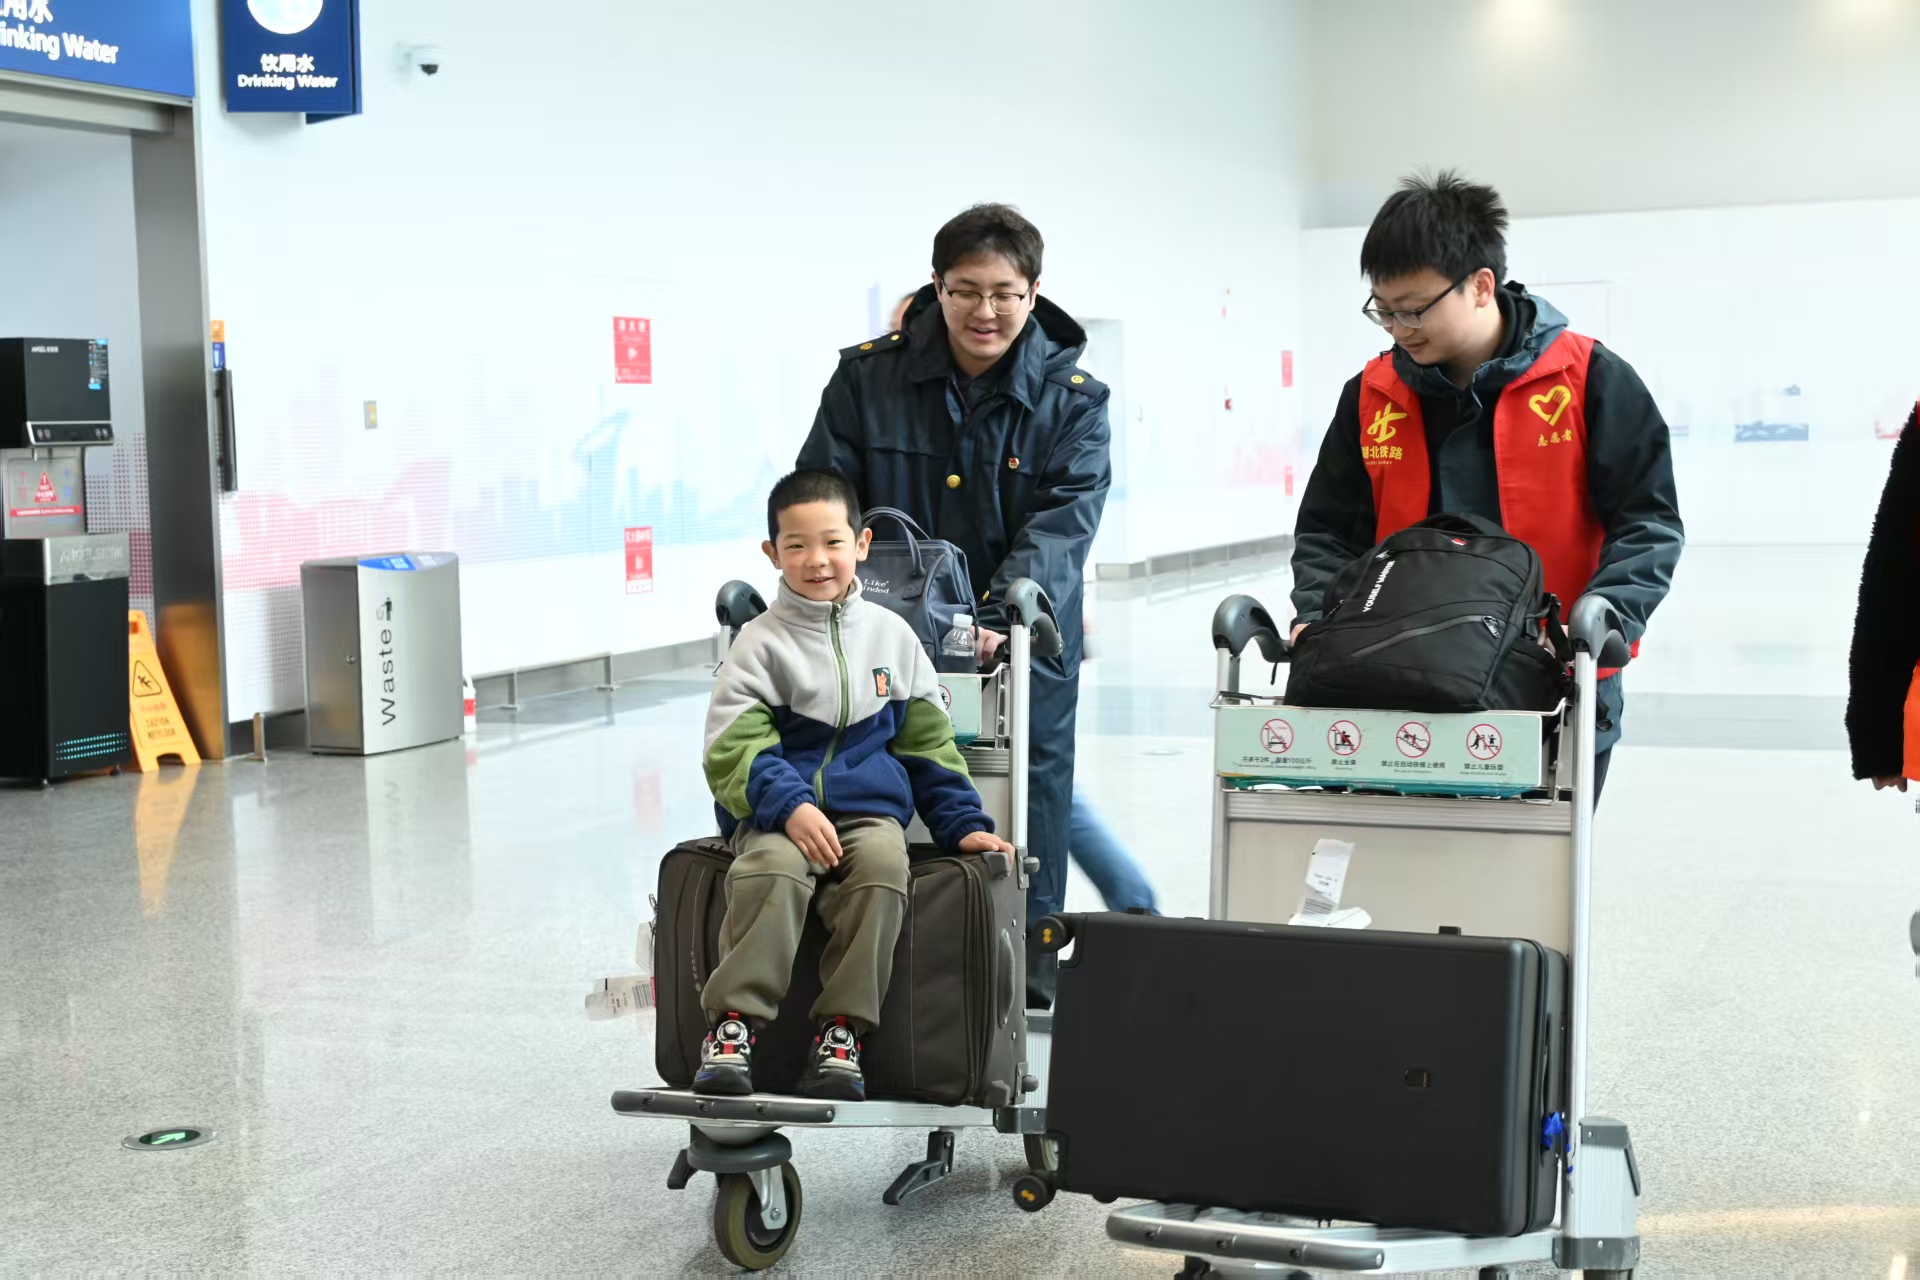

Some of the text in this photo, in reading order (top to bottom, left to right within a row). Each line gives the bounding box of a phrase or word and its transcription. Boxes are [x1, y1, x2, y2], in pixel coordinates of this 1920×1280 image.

[0, 21, 119, 64] inking Water
[260, 53, 315, 73] 饮用水
[237, 74, 338, 90] Drinking Water
[862, 584, 890, 594] inded
[378, 628, 396, 726] Waste
